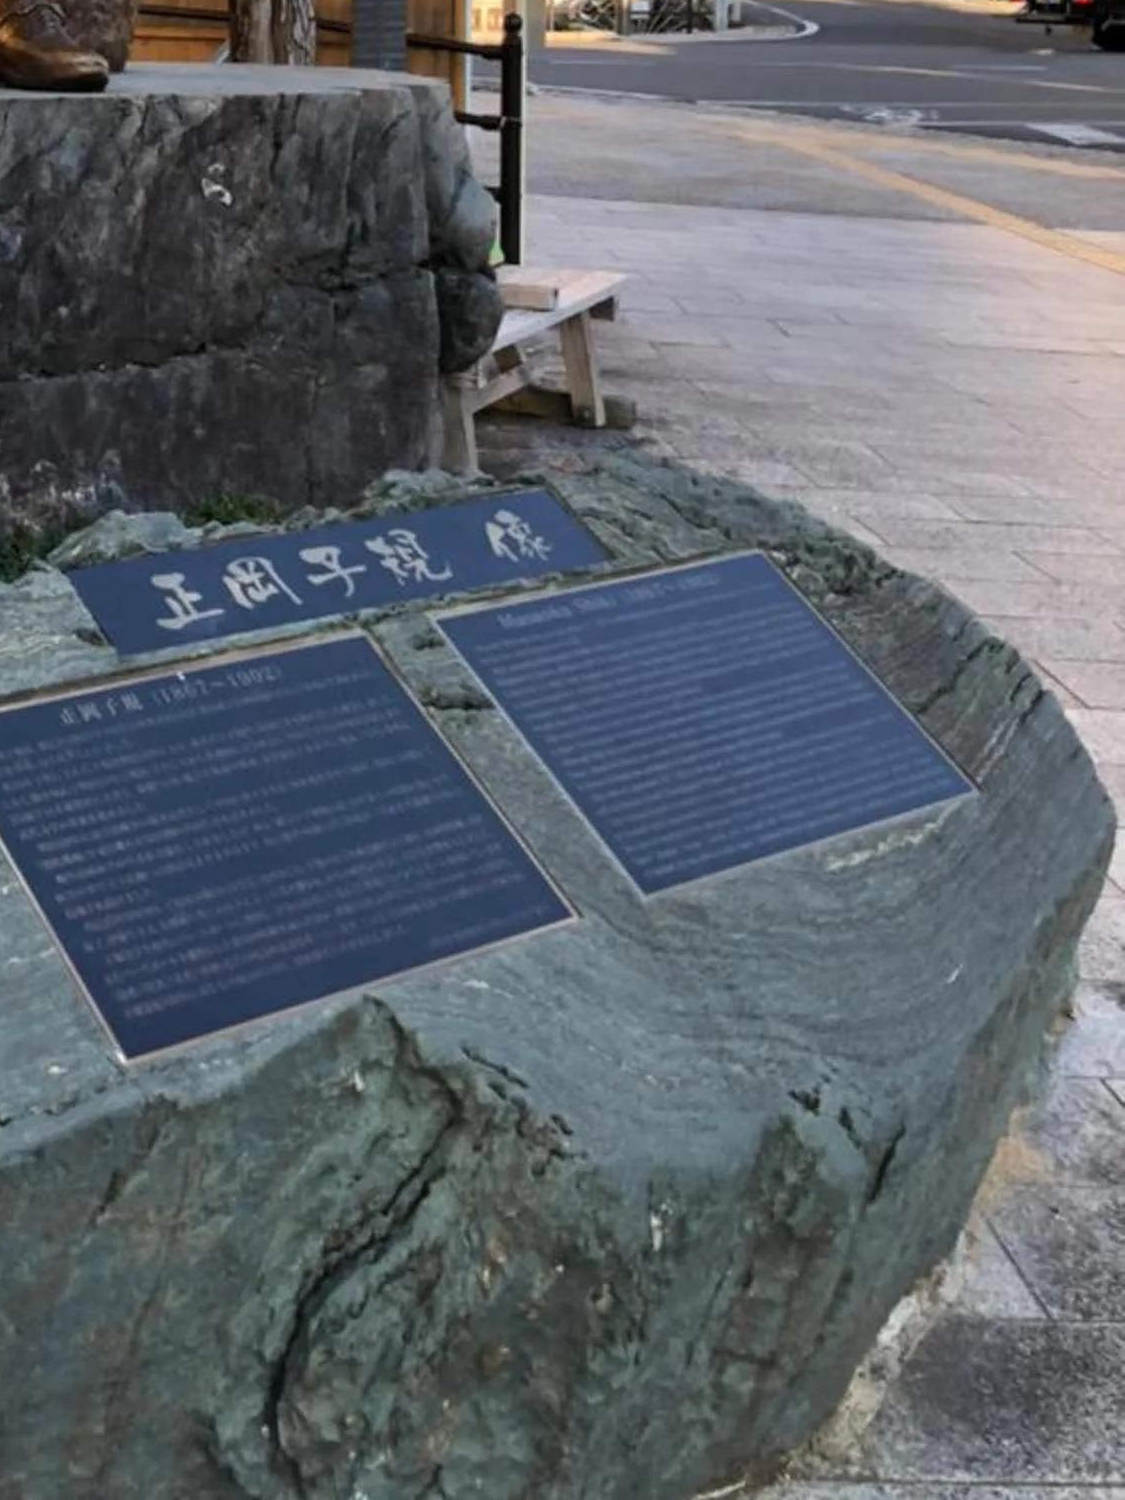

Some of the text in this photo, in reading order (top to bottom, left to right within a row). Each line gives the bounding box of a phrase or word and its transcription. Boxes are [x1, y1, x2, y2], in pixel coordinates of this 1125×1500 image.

[150, 508, 553, 631] 正岡子規 像
